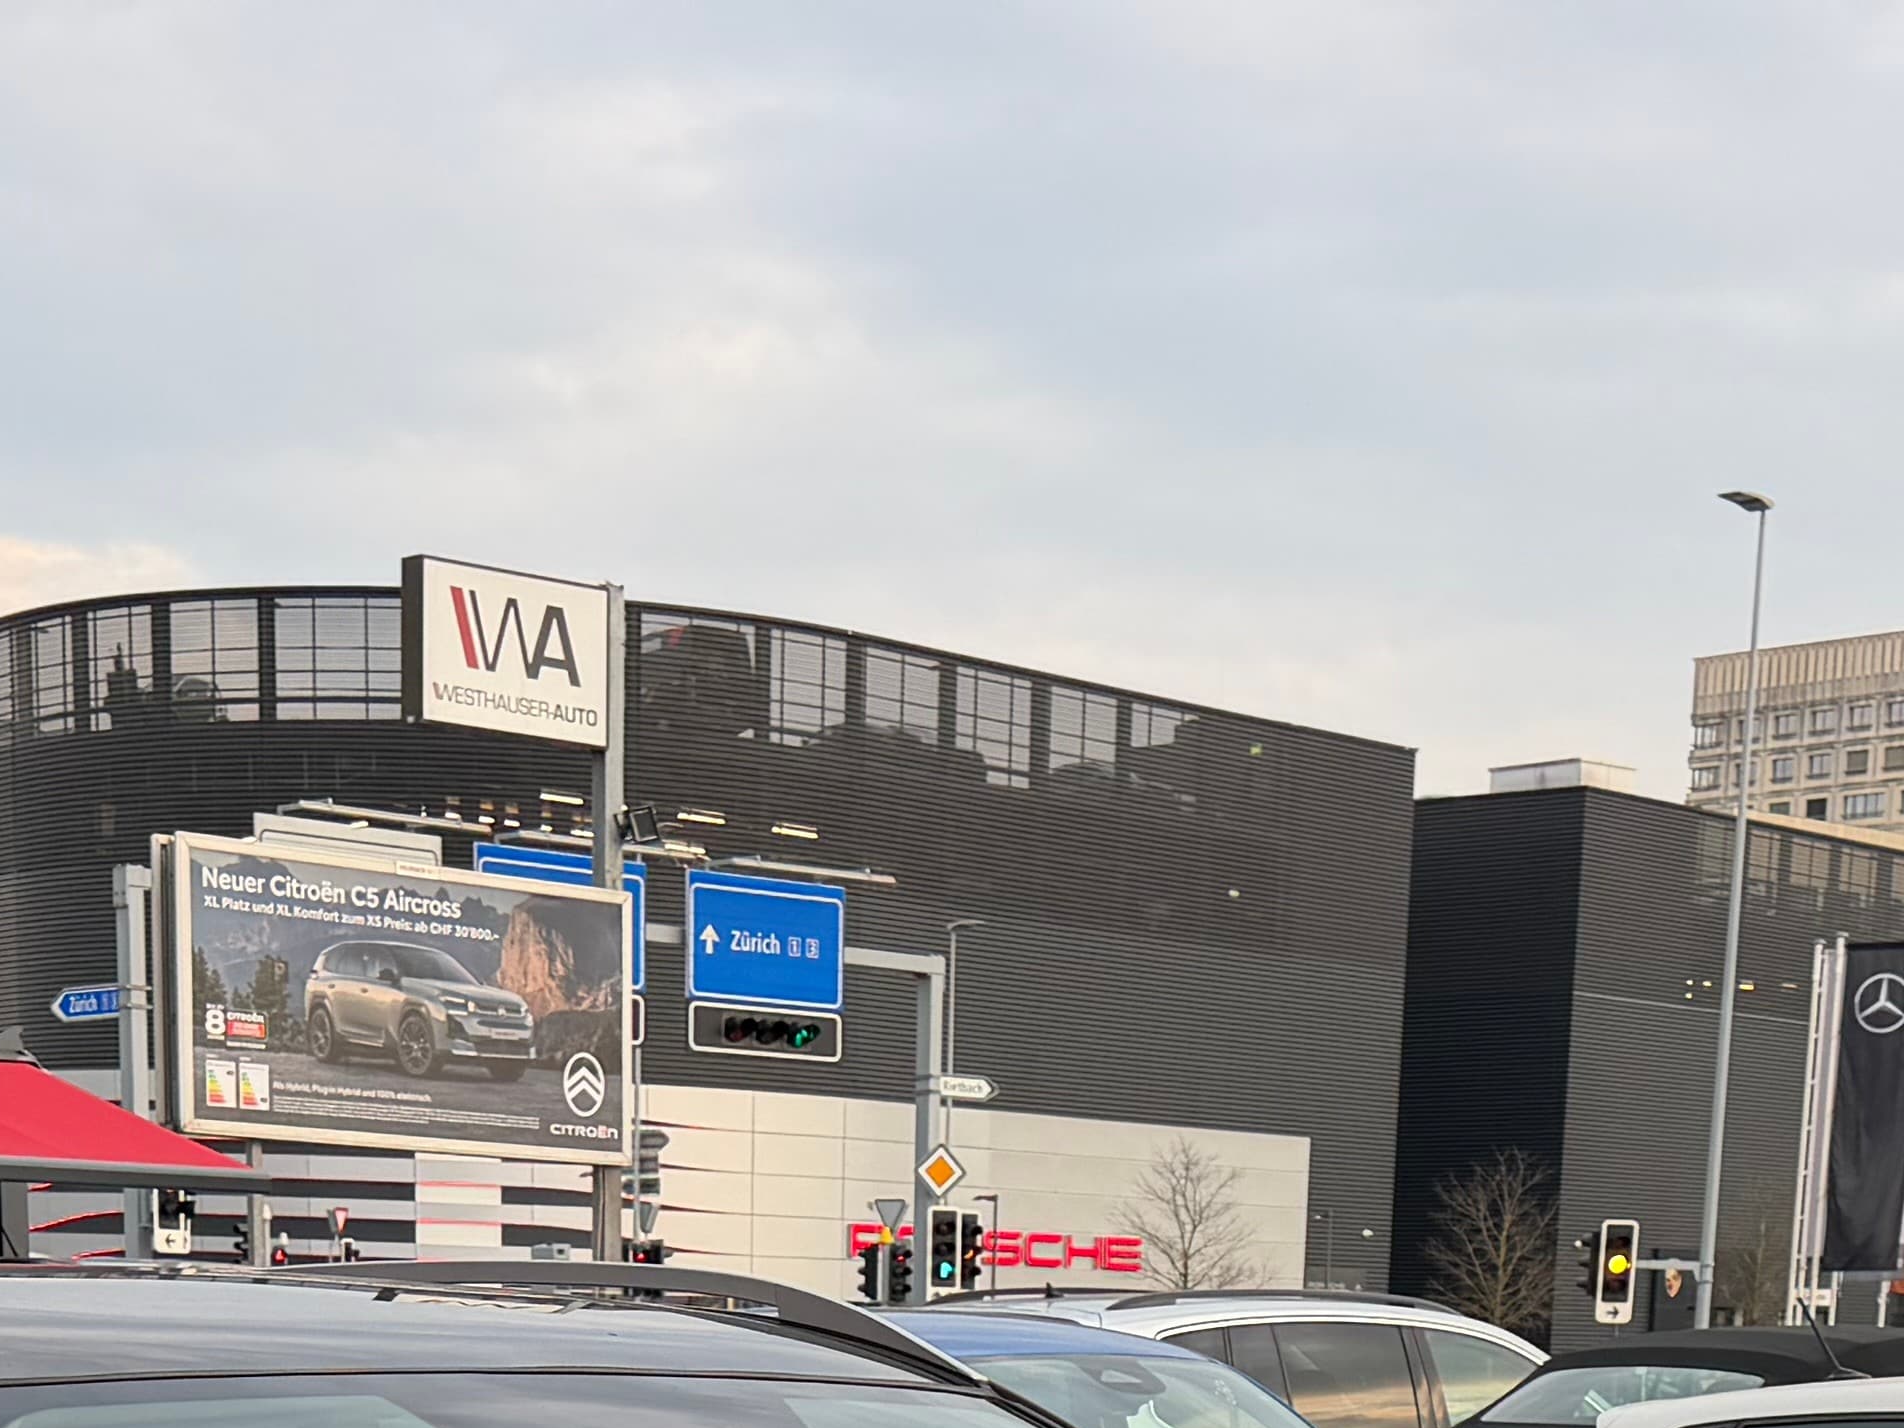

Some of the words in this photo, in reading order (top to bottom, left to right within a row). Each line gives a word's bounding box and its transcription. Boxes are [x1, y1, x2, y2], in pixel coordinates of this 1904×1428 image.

[201, 866, 265, 895] Neuer
[270, 874, 345, 905] Citroën
[351, 885, 379, 908] C5
[384, 890, 463, 919] Aircross
[203, 895, 220, 909] XL
[221, 897, 251, 912] Platz
[252, 901, 274, 914] und
[276, 904, 292, 917] XL
[293, 906, 339, 923] Komfort
[366, 914, 382, 928] XS
[414, 920, 428, 934] ab
[430, 922, 452, 936] CHF
[730, 929, 781, 956] Zürich
[205, 1009, 226, 1035] 8
[847, 1223, 1143, 1272] PSCHE
